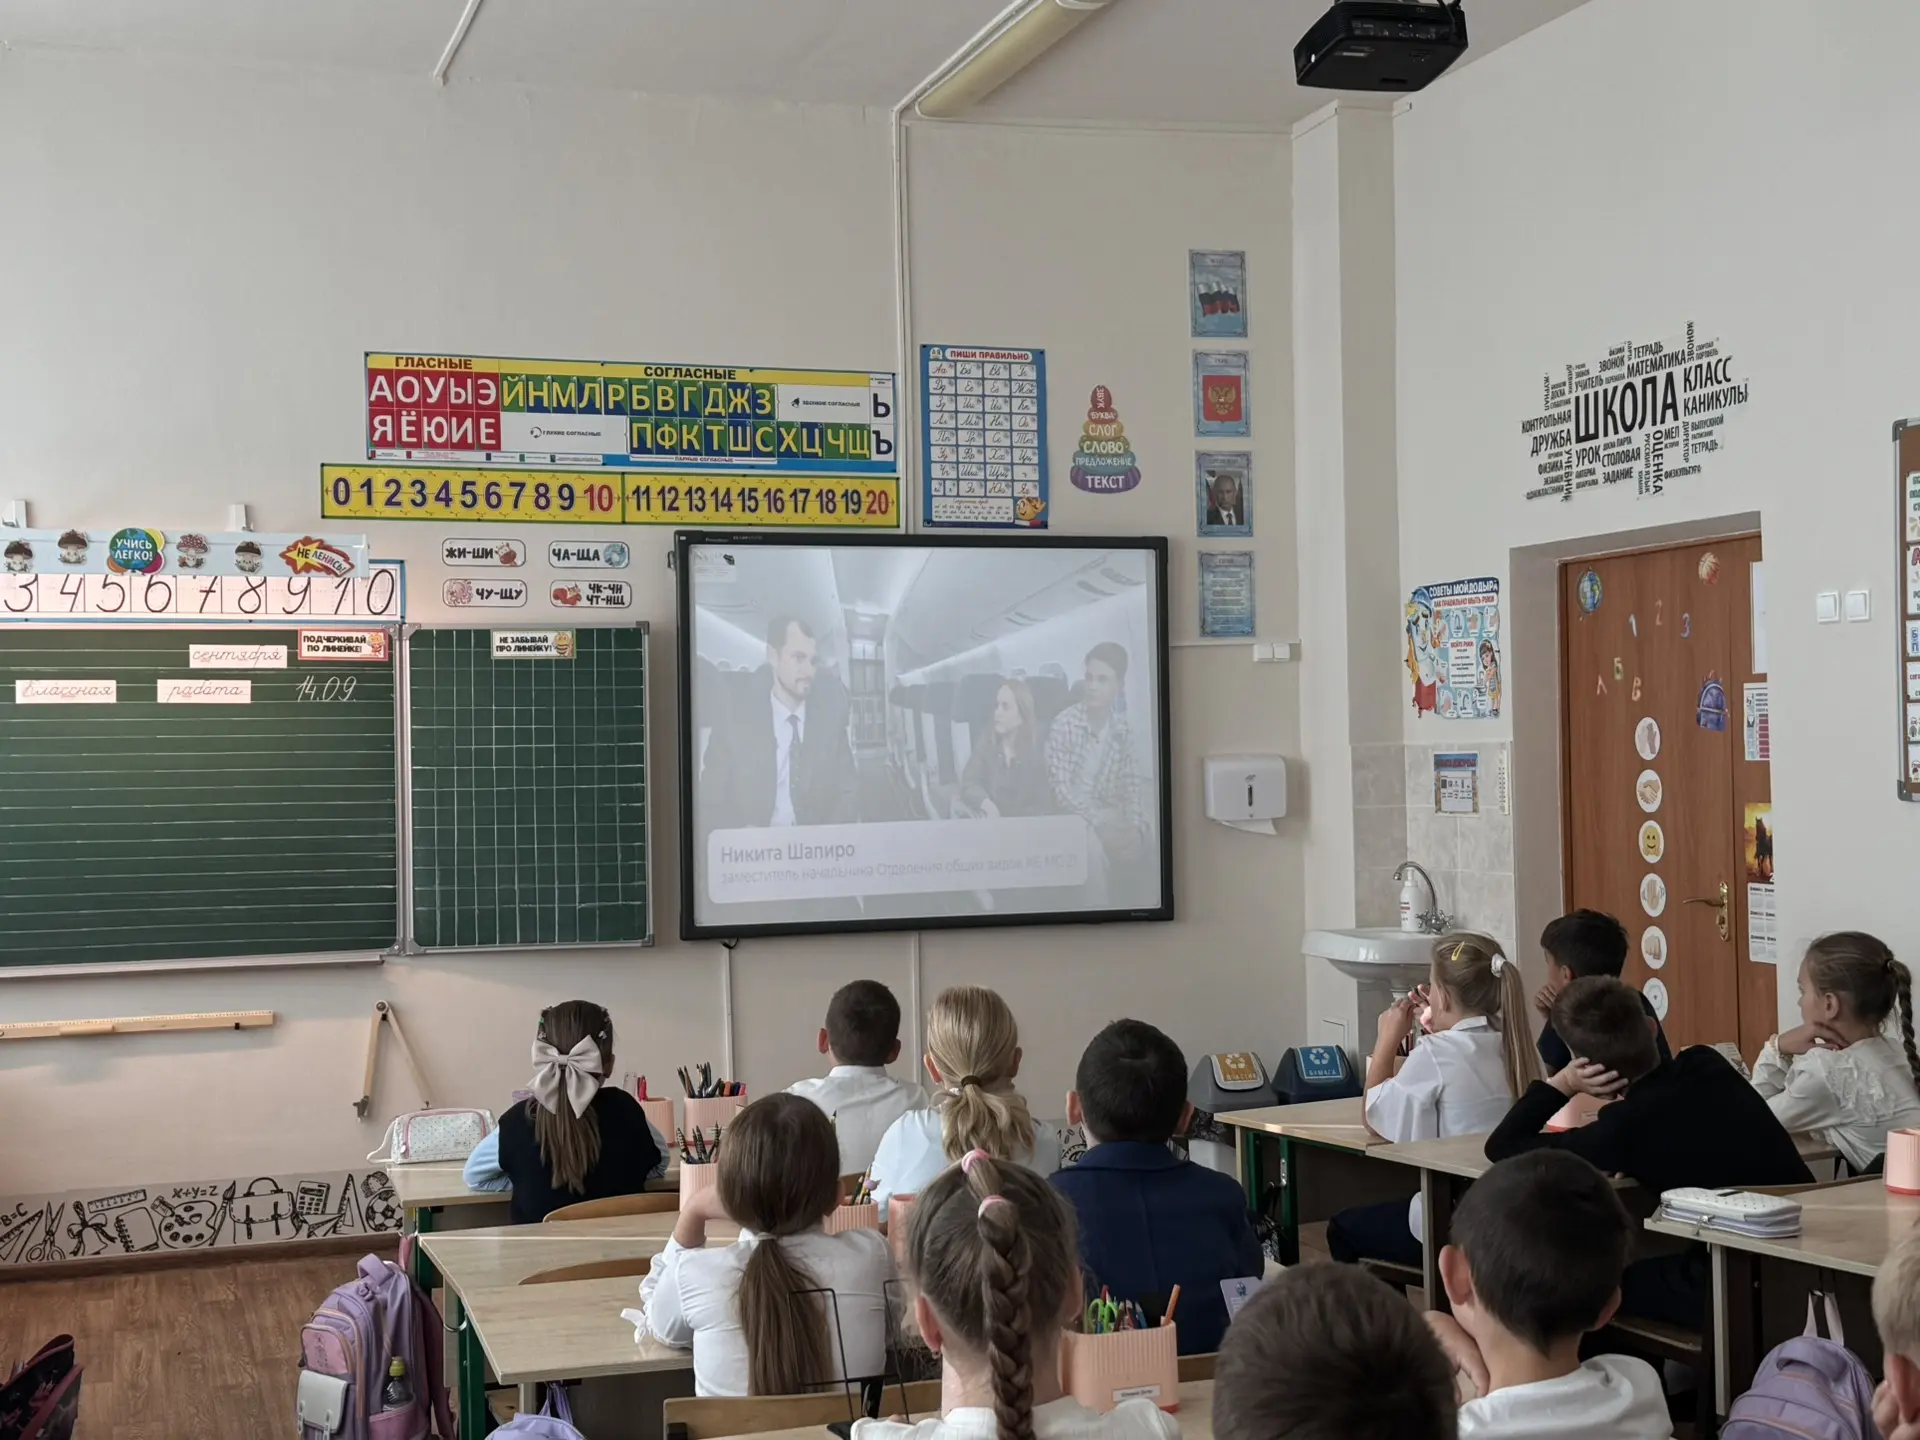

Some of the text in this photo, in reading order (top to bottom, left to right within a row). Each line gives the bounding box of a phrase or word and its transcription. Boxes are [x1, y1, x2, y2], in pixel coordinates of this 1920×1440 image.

[1687, 320, 1695, 362] ЗВОНОК
[950, 350, 1029, 360] ПИШИ ПРАВИЛЬНО
[1633, 341, 1664, 359] ТЕТРАДЬ
[395, 357, 473, 370] ГЛАСНЫЕ
[1599, 355, 1625, 373] ЗВОНОК
[1627, 349, 1686, 379] МАТЕМАТИКА
[644, 366, 737, 380] СОГЛАСНЫЕ
[1683, 356, 1732, 393] КЛАСС
[1575, 375, 1604, 393] УЧИТЕЛЬ
[1096, 387, 1105, 408] ЗВУК
[1683, 383, 1748, 417] КАНИКУЛЫ
[1091, 411, 1115, 419] БУКВА
[1575, 371, 1679, 444] ШКОЛА
[1521, 409, 1572, 433] КОНТРОЛЬНАЯ
[1691, 414, 1724, 431] ВЫПУСКНОЙ
[1088, 424, 1117, 436] СЛОГ
[1664, 426, 1680, 440] МЕЛ
[1083, 441, 1124, 453] СЛОВО
[1531, 428, 1572, 457] ДРУЖБА
[1691, 439, 1718, 454] ТЕТРАДЬ
[1075, 457, 1133, 467] ПРЕДЛОЖЕНИЕ
[1575, 444, 1601, 467] УРОК
[1601, 447, 1641, 468] СТОЛОВАЯ
[1651, 429, 1664, 495] ОЦЕНКА
[1538, 460, 1563, 475] ФИЗИКА
[1561, 448, 1573, 502] УЧЕБНИК
[1602, 467, 1634, 484] ЗАДАНИЕ
[1085, 475, 1125, 488] ТЕКСТ
[632, 485, 889, 515] 11 12 13 14 15 16 17 18 19 20
[116, 538, 153, 550] УЧИСЬ
[114, 550, 153, 562] ЛЕГКО!
[297, 547, 347, 573] НЕ ЛЕНИСЬ!
[445, 547, 494, 559] ЖИ-ШИ
[552, 548, 600, 562] ЧА-ЩА
[4, 573, 38, 613] 3
[60, 574, 83, 613] 4
[96, 574, 125, 613] 5
[144, 574, 172, 613] 6
[282, 576, 311, 614] 9
[475, 587, 523, 601] ЧУ-ЩУ
[588, 583, 623, 594] ЧК-ЧН
[1429, 579, 1499, 598] СОВЕТЫ МОЙДОДЫРА
[303, 634, 367, 644] ПОДЧЕРКИВАЙ
[510, 635, 549, 643] ЗАБЫВАЙ
[513, 643, 552, 652] ЛИНЕЙКУ!
[307, 644, 362, 653] ПО ЛИНЕЙКЕ!
[166, 679, 244, 702] работа
[721, 842, 855, 863] Никита Шапиро
[720, 869, 800, 885] заместитель
[802, 865, 874, 881] начальника
[0, 1202, 29, 1227] B=C
